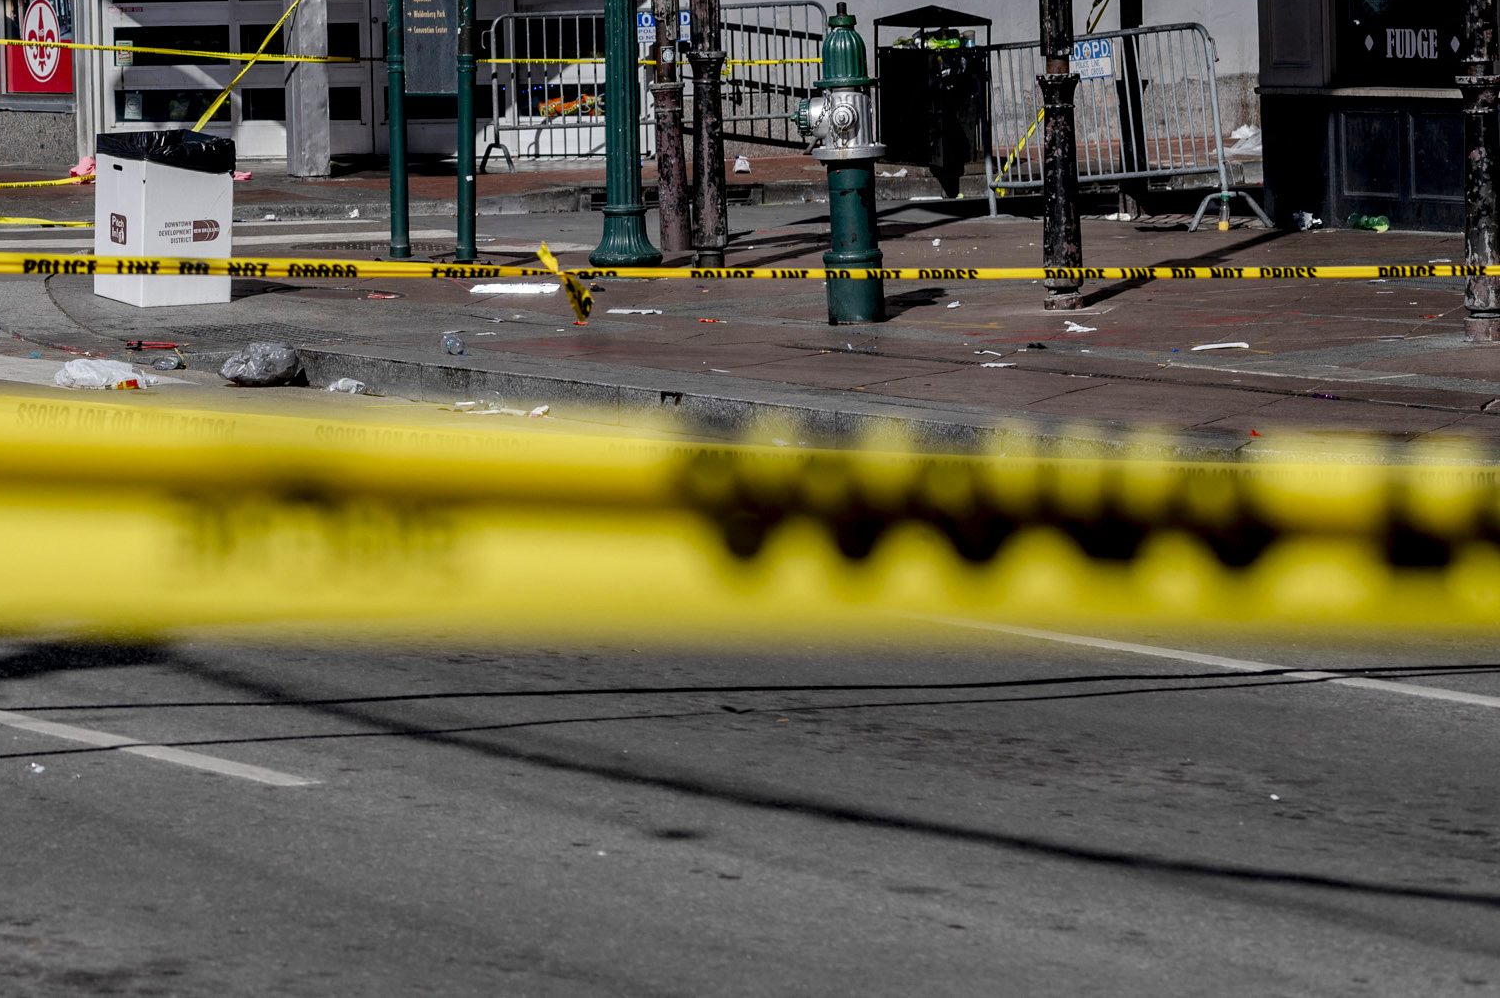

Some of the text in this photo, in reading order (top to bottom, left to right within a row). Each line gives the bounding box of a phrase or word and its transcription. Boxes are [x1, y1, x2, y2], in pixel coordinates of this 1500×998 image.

[437, 9, 446, 18] Park
[413, 26, 448, 34] Convention Center
[1385, 28, 1438, 59] FUDGE
[165, 221, 192, 229] DOWNTOWN
[158, 228, 192, 237] DEVELOPMENT
